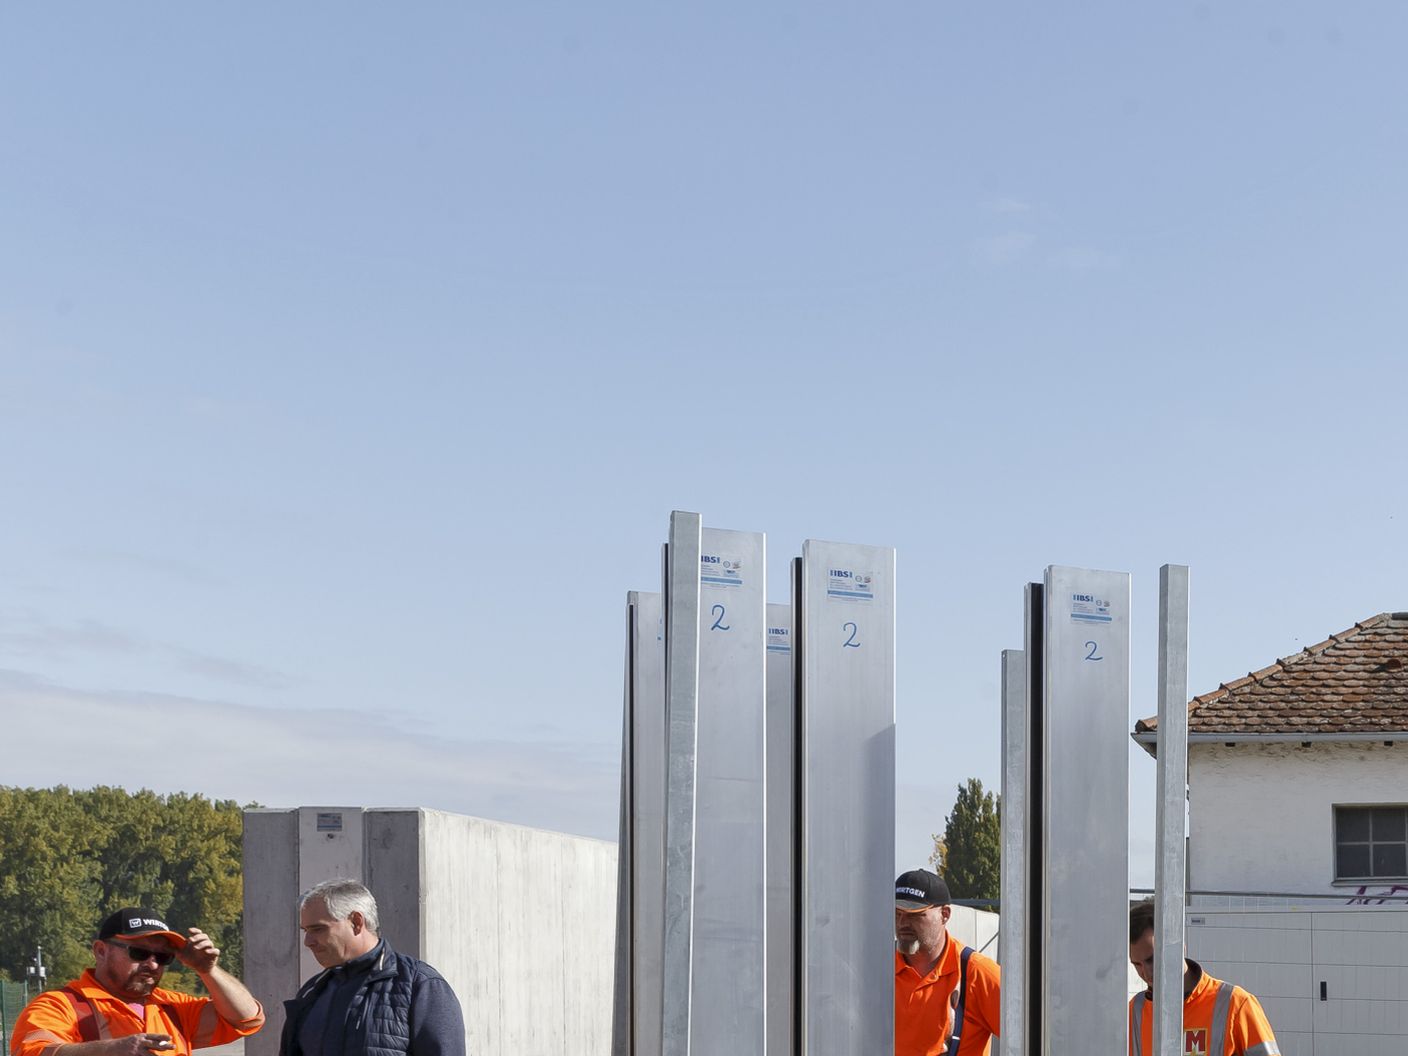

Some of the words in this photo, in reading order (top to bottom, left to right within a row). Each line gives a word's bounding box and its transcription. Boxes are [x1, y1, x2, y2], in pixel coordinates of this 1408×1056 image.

[711, 604, 730, 631] 2
[843, 622, 861, 648] 2
[1085, 641, 1103, 661] 2
